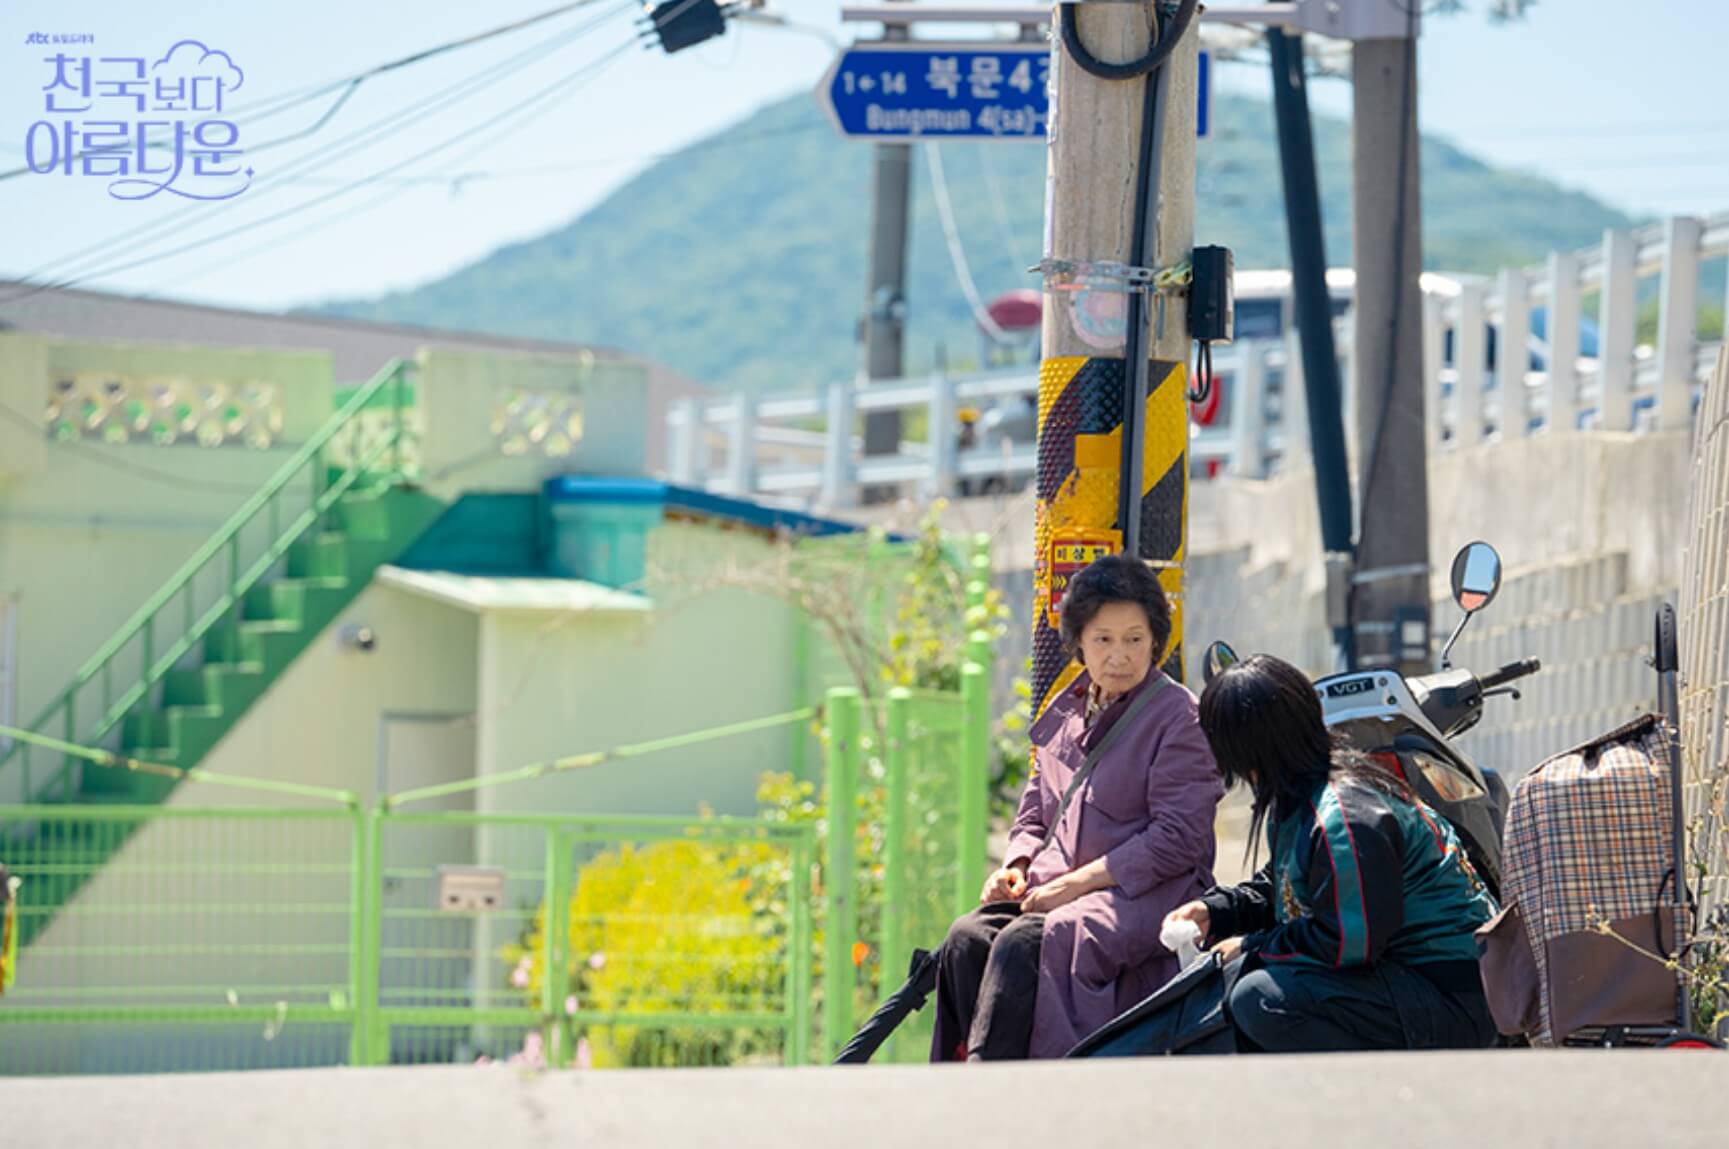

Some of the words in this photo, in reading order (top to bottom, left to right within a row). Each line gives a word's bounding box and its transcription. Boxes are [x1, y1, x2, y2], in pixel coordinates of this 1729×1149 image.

[843, 71, 855, 95] 1
[880, 71, 907, 95] 14
[977, 105, 1049, 136] 4(sa)-
[1333, 679, 1369, 694] VGT
